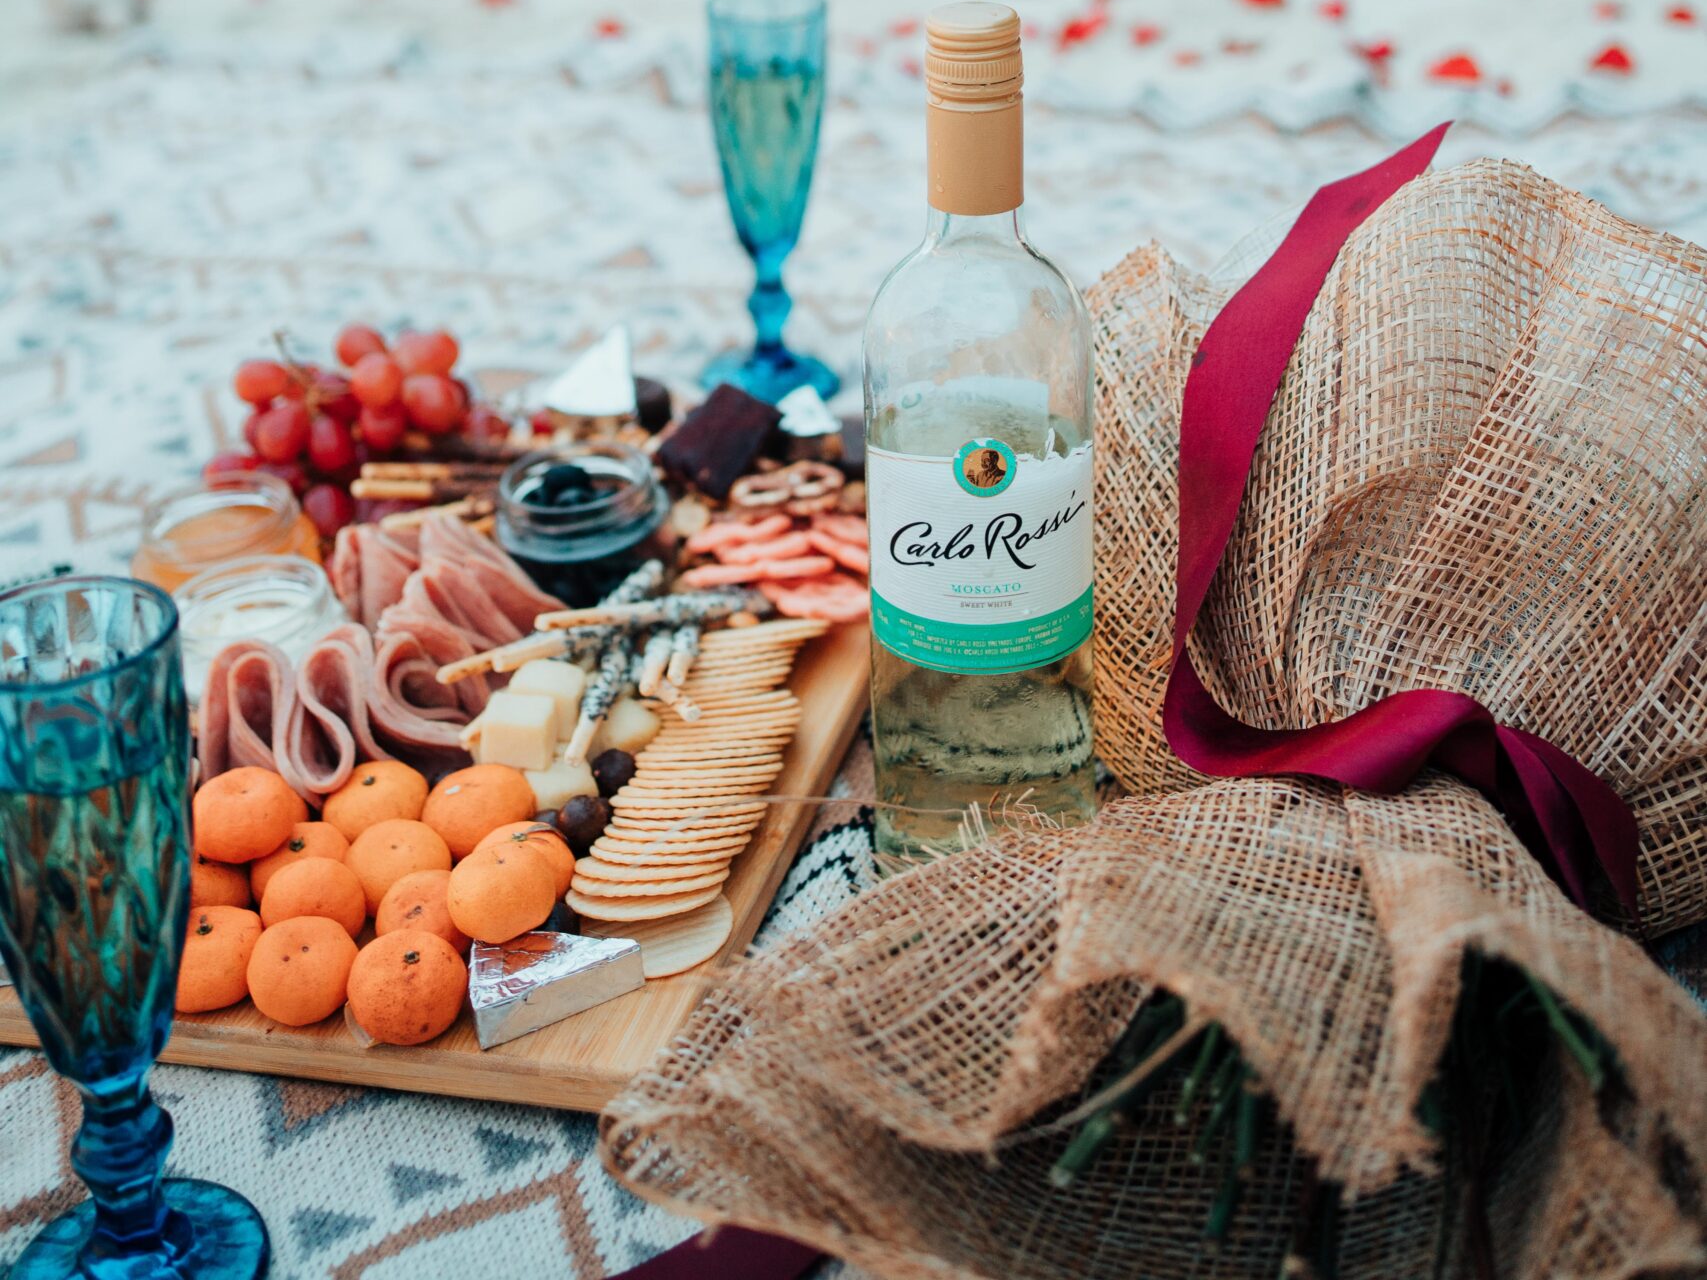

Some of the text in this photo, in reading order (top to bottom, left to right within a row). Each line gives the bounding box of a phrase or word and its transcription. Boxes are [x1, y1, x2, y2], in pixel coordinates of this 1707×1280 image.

[889, 489, 1087, 570] Carlo Rossi
[952, 583, 1022, 594] MOSCATO
[960, 600, 1013, 609] SWEET WHITE
